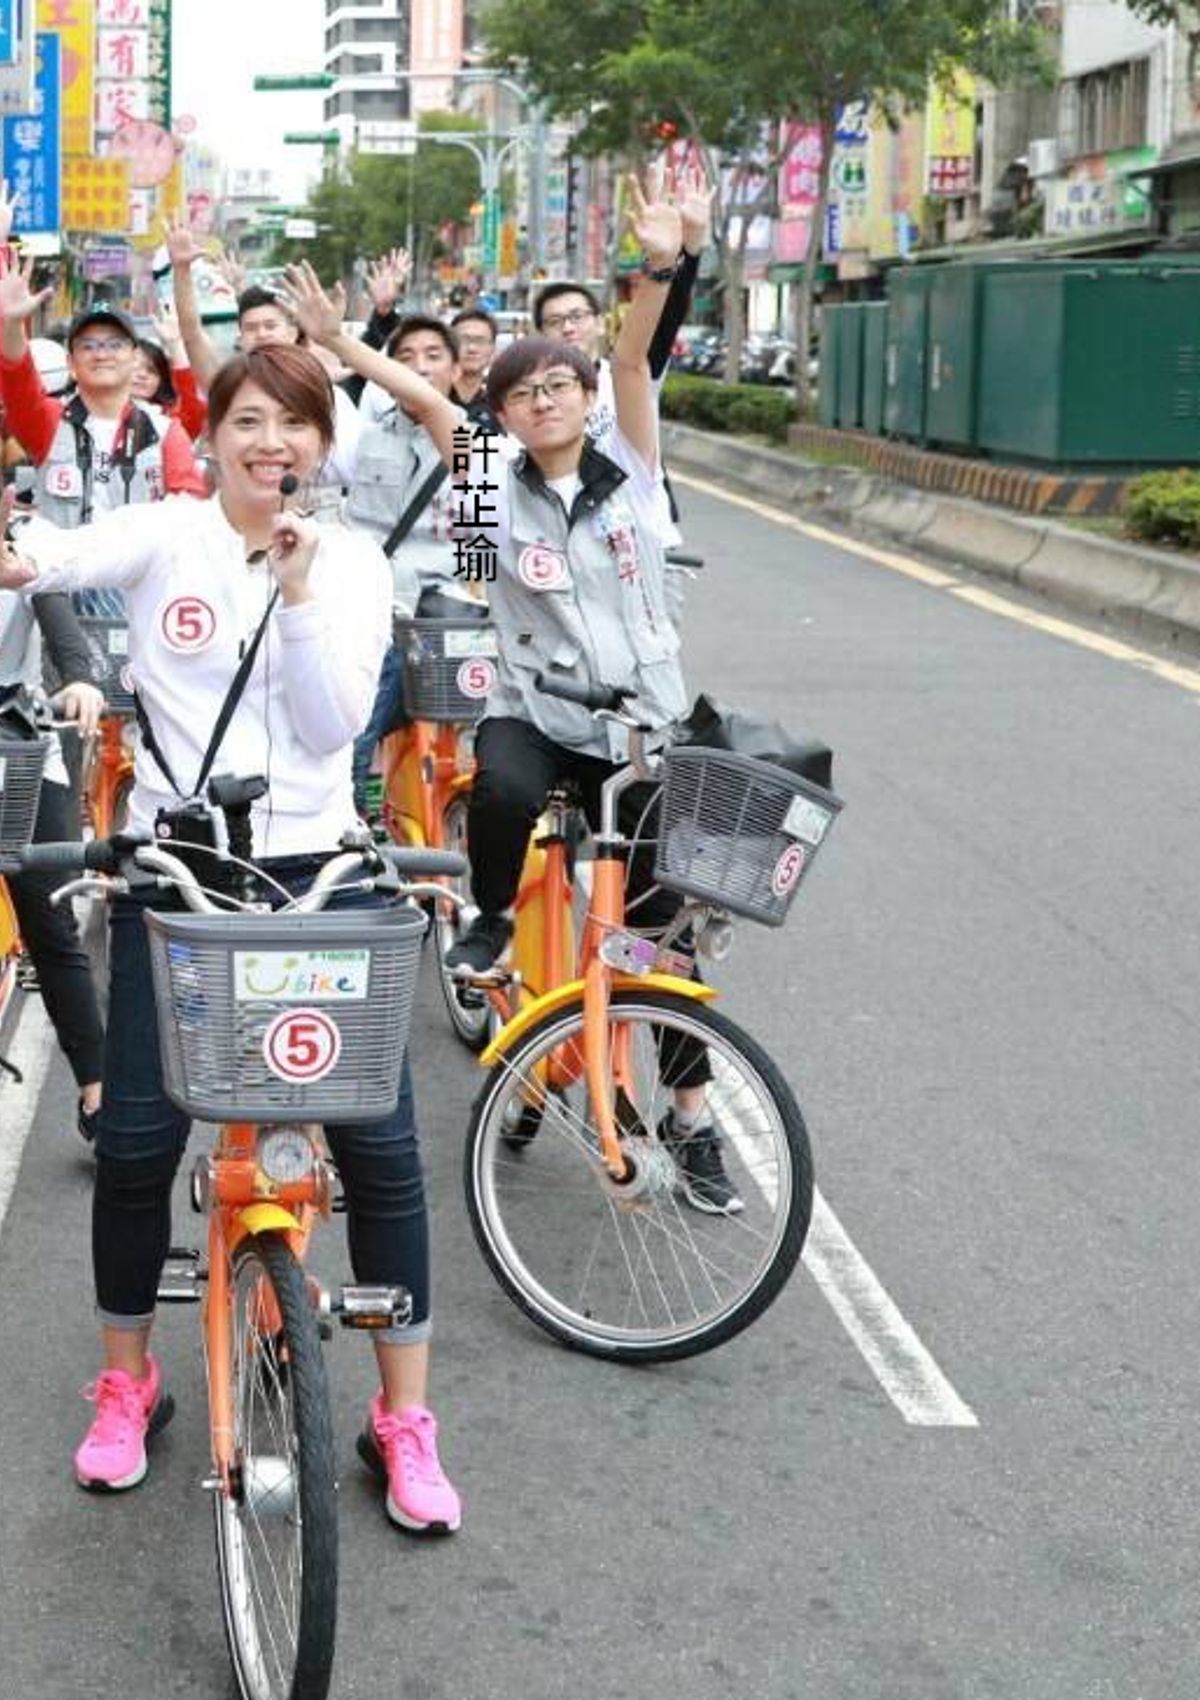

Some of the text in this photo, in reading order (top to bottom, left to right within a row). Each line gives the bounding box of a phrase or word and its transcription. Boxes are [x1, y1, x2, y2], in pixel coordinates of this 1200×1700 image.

[175, 606, 203, 641] 5
[468, 667, 486, 689] 5
[286, 1025, 320, 1067] 5
